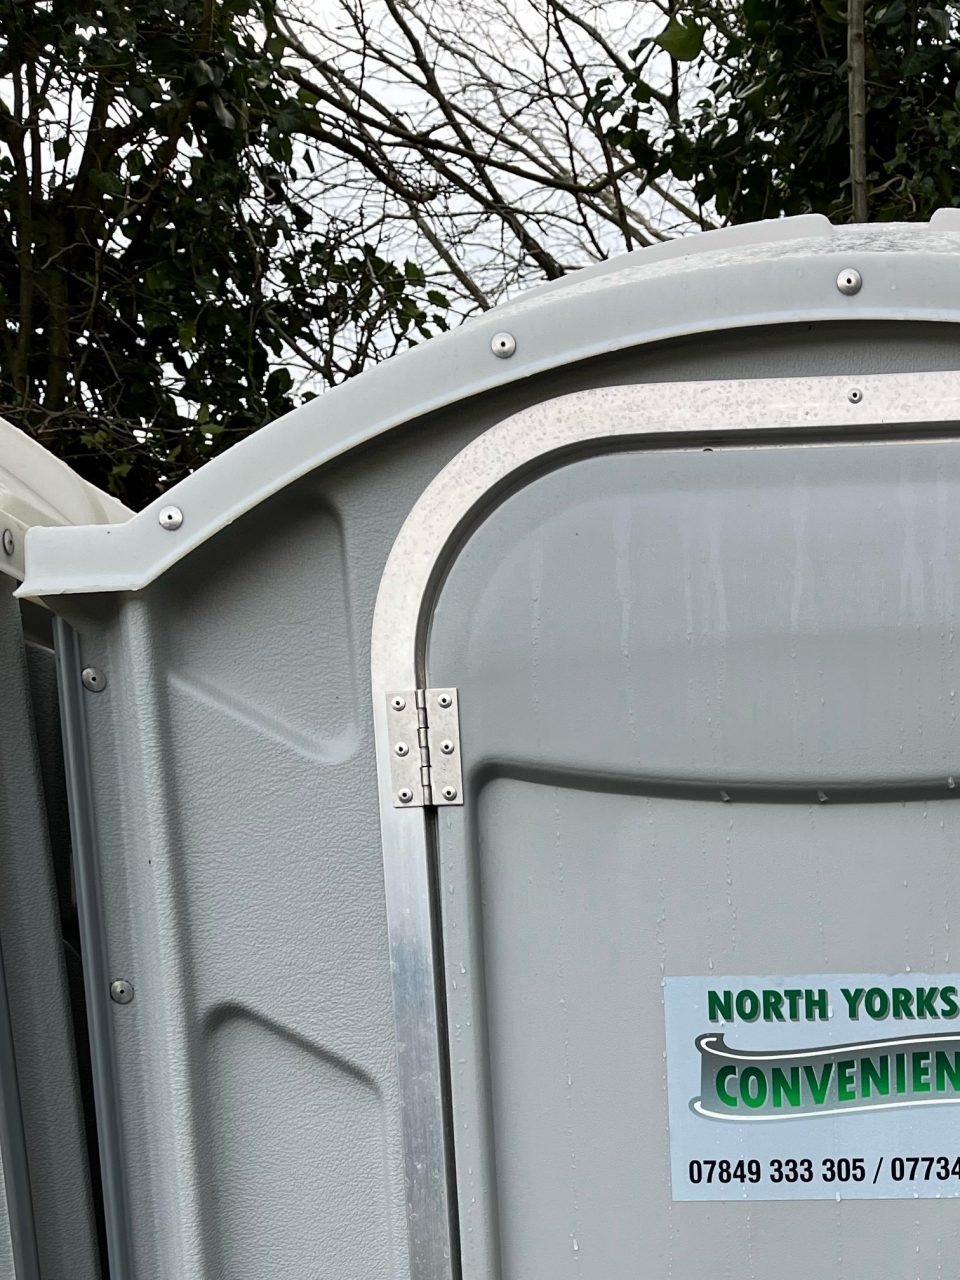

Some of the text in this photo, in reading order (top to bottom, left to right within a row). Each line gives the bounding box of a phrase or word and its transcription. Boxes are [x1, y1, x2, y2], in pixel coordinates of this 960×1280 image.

[708, 988, 829, 1022] NORTH
[689, 1159, 761, 1184] 07849
[769, 1158, 814, 1183] 333
[822, 1157, 866, 1182] 305
[873, 1156, 884, 1184] /
